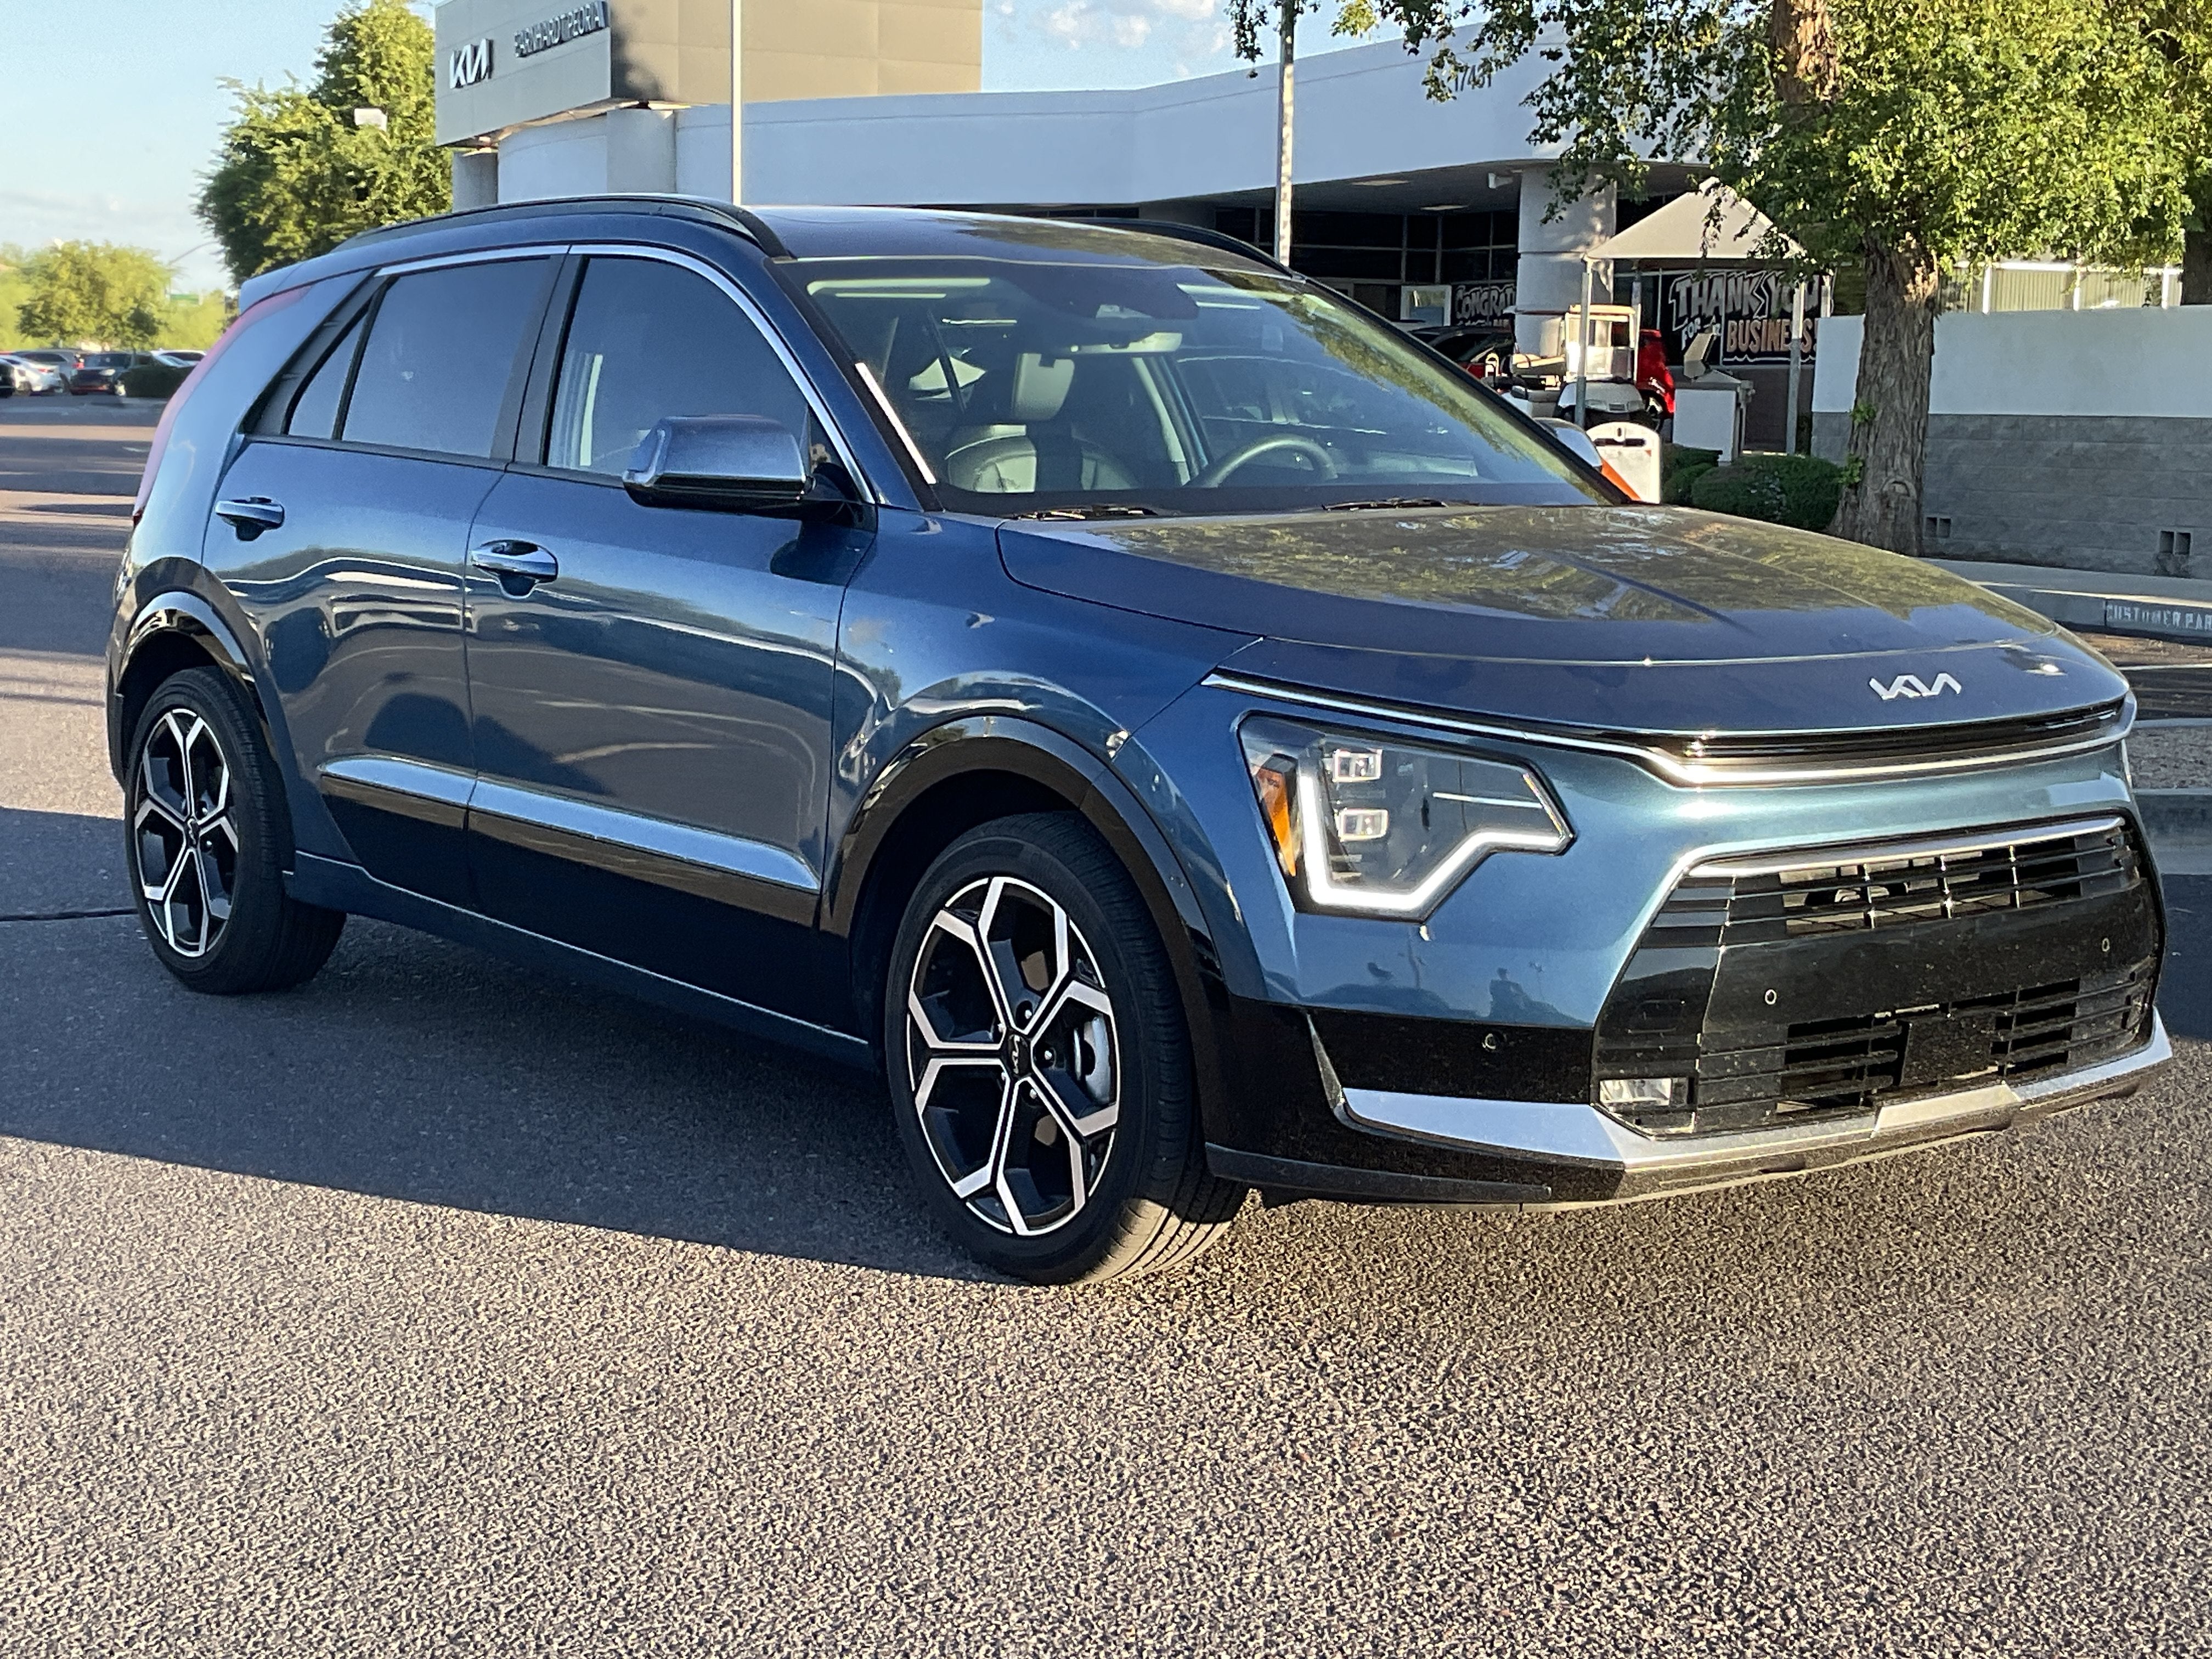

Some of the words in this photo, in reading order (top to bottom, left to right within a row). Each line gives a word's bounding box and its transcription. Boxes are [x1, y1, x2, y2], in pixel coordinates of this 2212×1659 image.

[449, 38, 492, 88] KIA
[1675, 274, 1763, 318] THANK
[1767, 274, 1820, 314] YOU
[1681, 317, 1701, 351] FOR
[1726, 318, 1818, 353] BUSINES!
[2107, 604, 2181, 627] CUSTOMER
[1869, 672, 1962, 701] KIA
